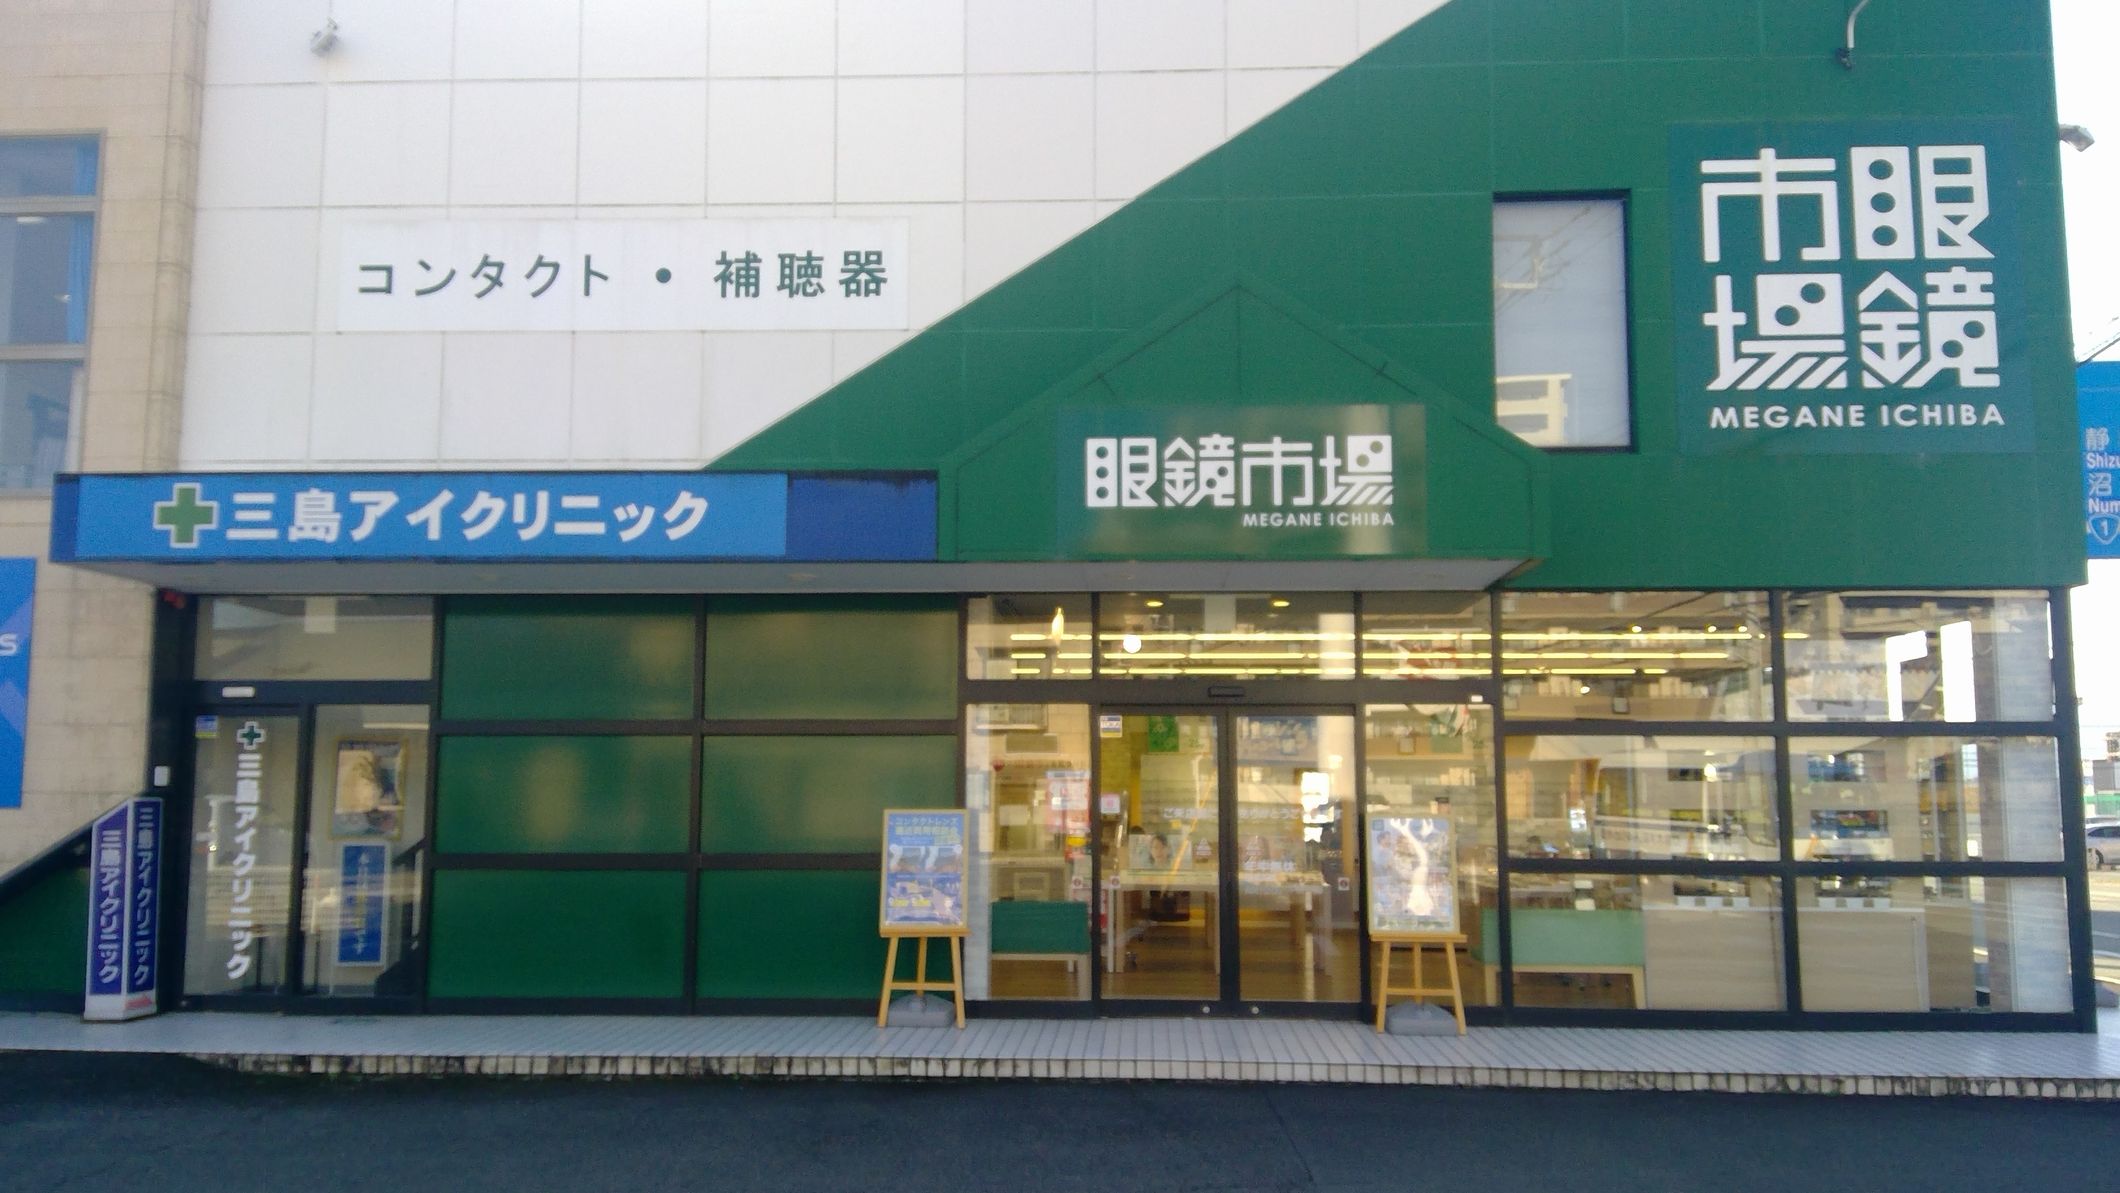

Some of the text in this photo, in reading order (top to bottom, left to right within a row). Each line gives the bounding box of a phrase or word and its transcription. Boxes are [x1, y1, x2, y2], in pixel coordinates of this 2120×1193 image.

[358, 250, 888, 299] コンタクト・補聴器
[1710, 403, 2005, 429] MEGANE ICHIBA
[1086, 434, 1394, 507] 眼鏡市場
[226, 488, 709, 543] 三島アイクリニック
[1243, 511, 1394, 527] MEGANE ICHIBA
[2101, 519, 2109, 536] 1
